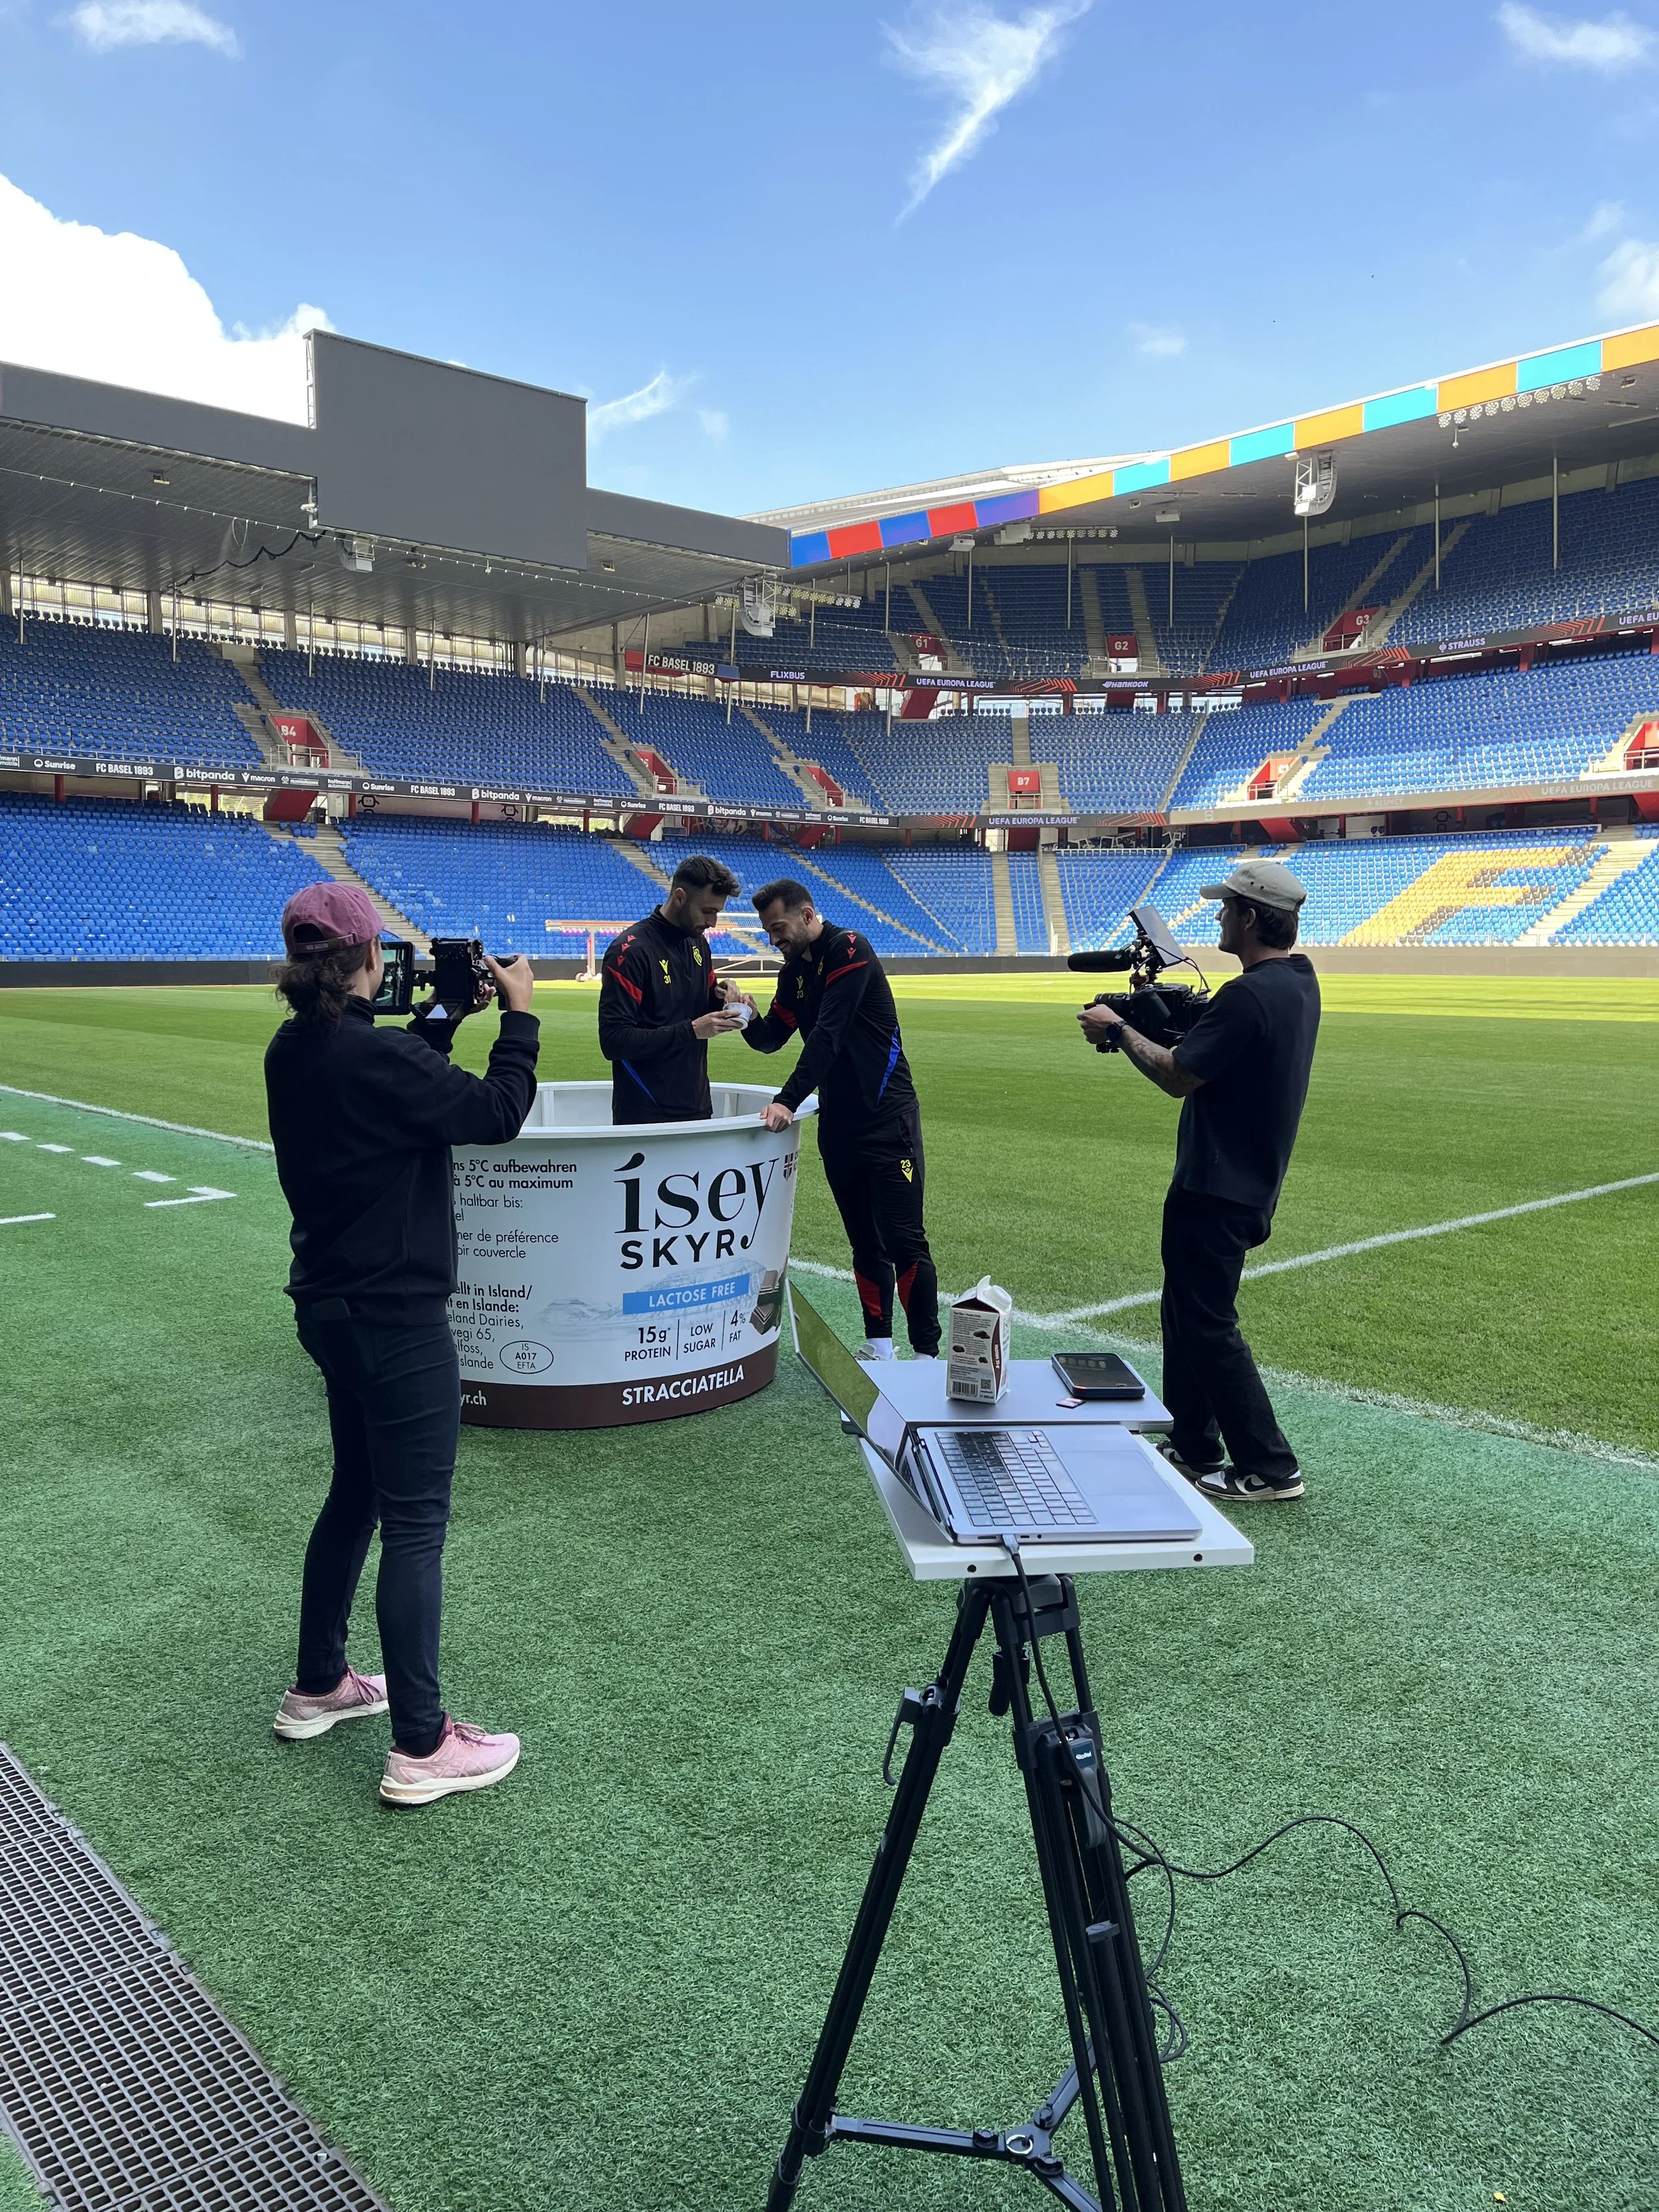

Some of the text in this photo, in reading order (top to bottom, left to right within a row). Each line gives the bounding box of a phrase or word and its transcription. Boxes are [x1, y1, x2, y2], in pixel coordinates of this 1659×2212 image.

[1356, 615, 1370, 626] G3
[1619, 611, 1659, 625] UEFA EU
[916, 639, 928, 648] G1
[1115, 641, 1128, 650] G2
[1448, 638, 1486, 650] STRAUSS
[648, 654, 715, 675] FC BASEL 1893
[1250, 669, 1268, 679] UEFA
[1269, 666, 1297, 676] EUROPA
[44, 760, 76, 770] Sunrise
[96, 763, 154, 776] FC BASEL 1893
[186, 768, 236, 781] bitpanda
[250, 774, 275, 783] macron
[1017, 776, 1030, 786] B7
[370, 783, 395, 792] Sunrise
[411, 784, 455, 796] FC BASEL 1893
[1542, 778, 1653, 795] UEFA EUROPA LEAGUE
[481, 789, 520, 801] bitpanda
[666, 803, 682, 812] BASEL
[1375, 798, 1404, 807] RESPECT
[715, 806, 746, 816] bitpanda
[469, 1159, 489, 1172] 5°C
[493, 1159, 577, 1173] aufbewahren
[901, 1159, 911, 1168] 23
[465, 1175, 484, 1188] 5°C
[488, 1179, 504, 1188] au
[509, 1176, 573, 1189] maximum
[460, 1193, 499, 1207] haltbar
[504, 1195, 523, 1208] bis:
[614, 1152, 780, 1249] ísey
[455, 1208, 465, 1221] el
[477, 1228, 492, 1242] de
[496, 1229, 559, 1246] préférence
[457, 1244, 526, 1258] oir couvercle
[620, 1228, 735, 1270] SKYR
[456, 1282, 532, 1300] ellt in Island/
[649, 1282, 736, 1307] LACTOSE FREE
[456, 1301, 469, 1310] en
[472, 1298, 519, 1313] Islande:
[447, 1310, 524, 1329] eland Dairies,
[731, 1309, 746, 1327] 4%
[451, 1328, 495, 1343] vegi 65,
[690, 1323, 713, 1337] LOW
[729, 1330, 741, 1343] FAT
[455, 1339, 483, 1356] elfoss,
[684, 1338, 716, 1353] SUGAR
[515, 1352, 537, 1361] A017
[624, 1346, 671, 1361] PROTEIN
[622, 1364, 745, 1406] STRACCIATELLA
[461, 1390, 486, 1406] yr.ch
